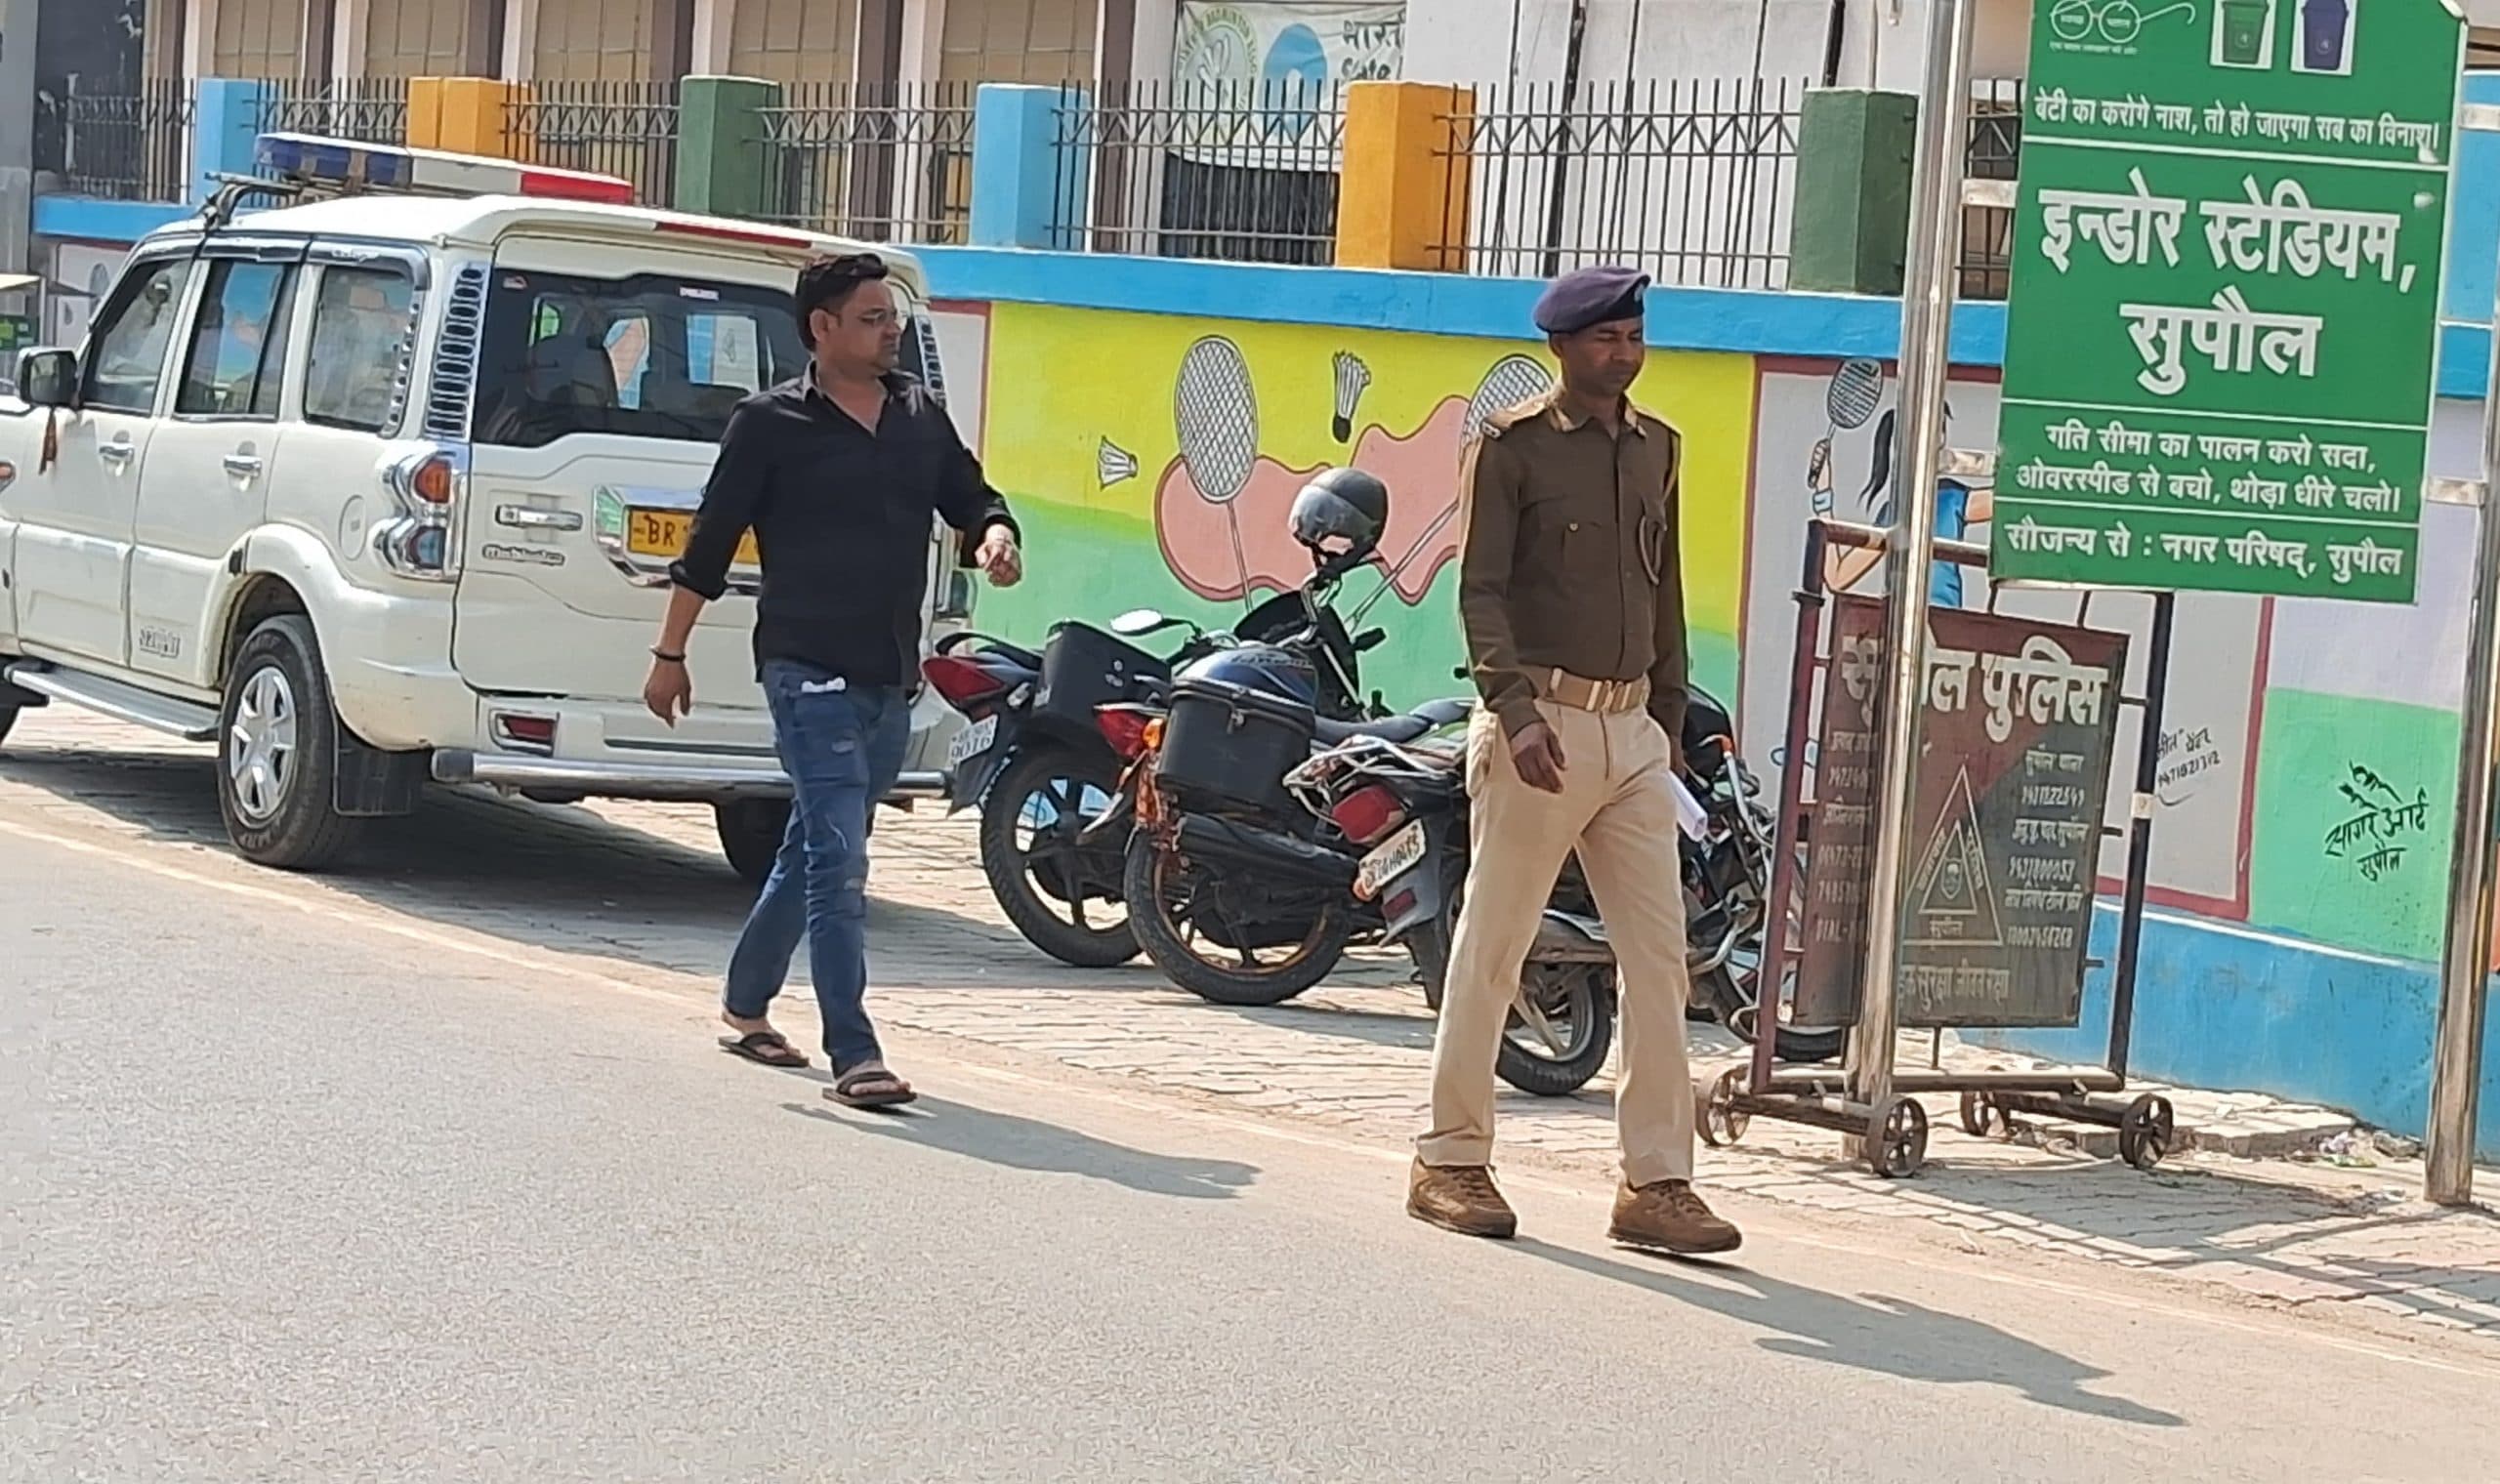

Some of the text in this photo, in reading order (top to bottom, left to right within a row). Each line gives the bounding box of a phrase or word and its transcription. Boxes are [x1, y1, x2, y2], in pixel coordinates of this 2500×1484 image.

[2034, 87, 2067, 121] बेटी
[2071, 98, 2097, 124] का
[2101, 95, 2150, 128] करोगे
[2154, 105, 2197, 135] नाश,
[2204, 100, 2226, 133] तो
[2229, 103, 2251, 137] हो
[2255, 112, 2311, 143] जाएगा
[2315, 116, 2345, 143] सब
[2349, 118, 2374, 144] का
[2038, 167, 2418, 294] इन्डोर स्टेडियम,
[2119, 285, 2323, 395] सुपौल
[2045, 418, 2376, 474] गति सीमा का पालन करो सदा,
[2017, 456, 2400, 513] ओवरस्पीड से बचो, थोड़ा धीरे चलो।
[2004, 515, 2098, 556] सौजन्य
[2104, 520, 2132, 557] से
[2159, 533, 2219, 563] नगर
[2224, 529, 2316, 579] परिषद्,
[2325, 537, 2404, 584] सुपौल
[1981, 636, 2109, 744] पुलिस
